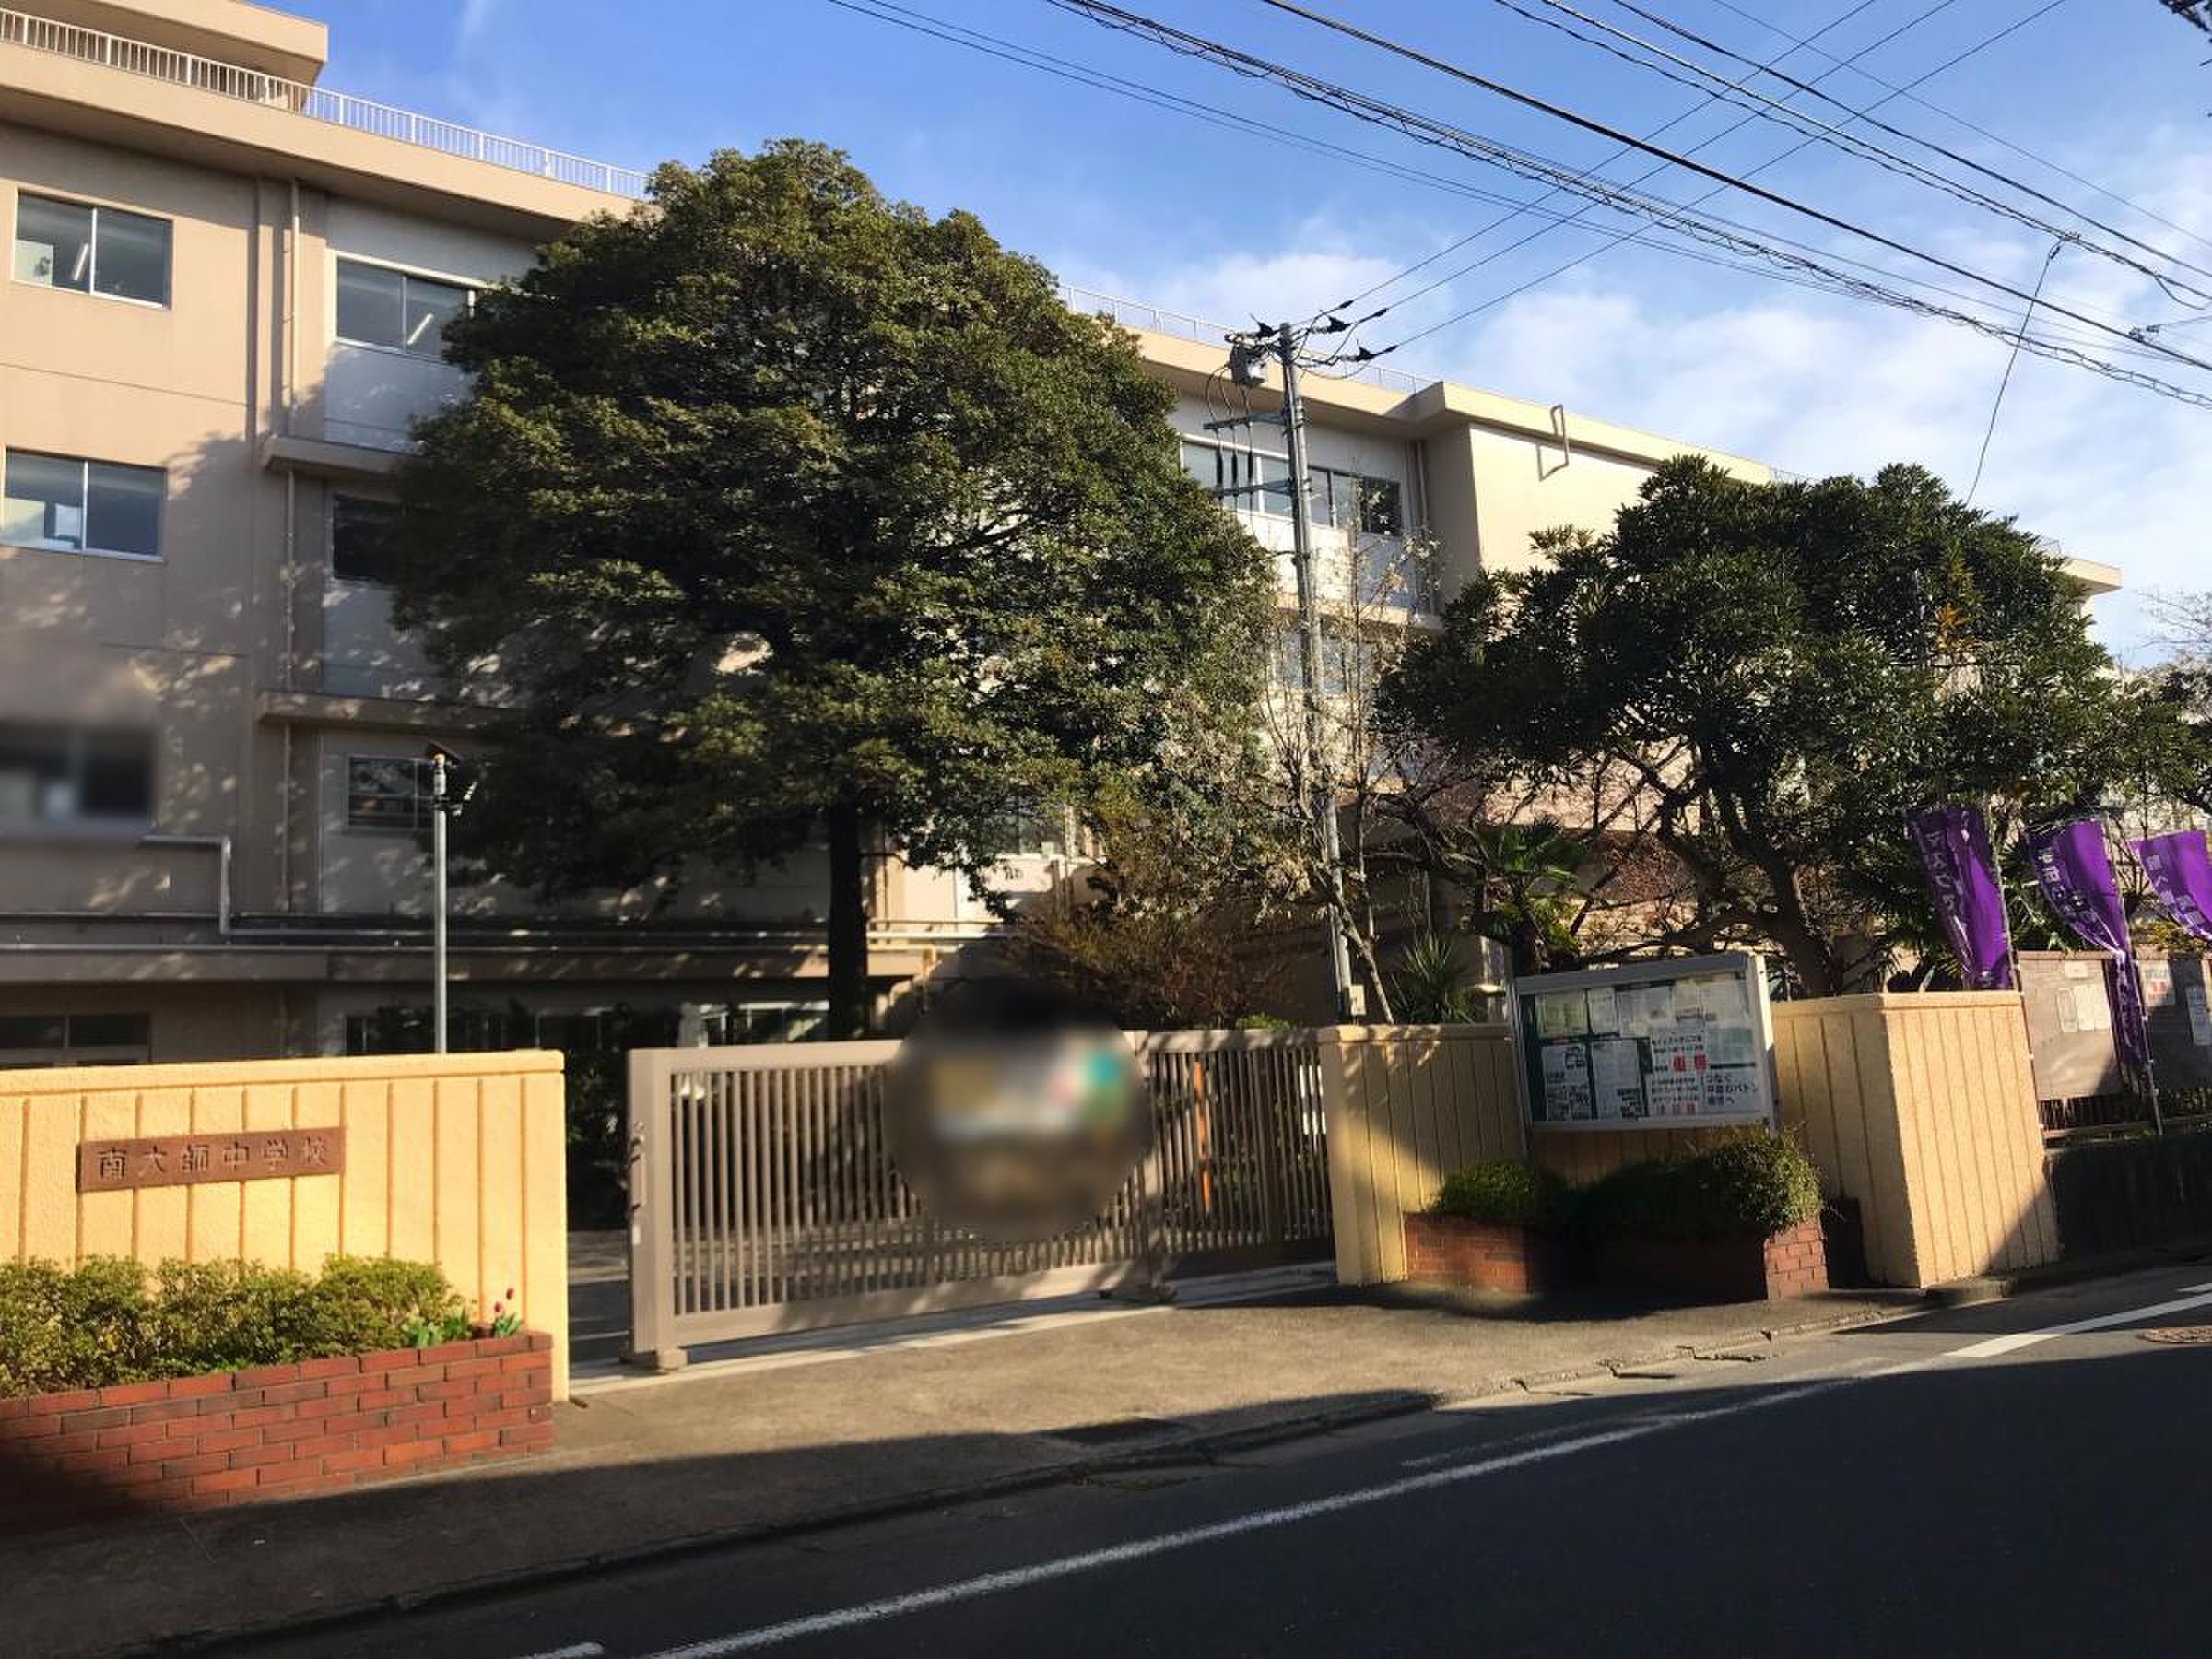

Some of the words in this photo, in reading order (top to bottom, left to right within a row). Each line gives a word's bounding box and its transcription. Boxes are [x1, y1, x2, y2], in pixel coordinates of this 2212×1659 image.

[98, 1136, 326, 1181] 南大師中学校
